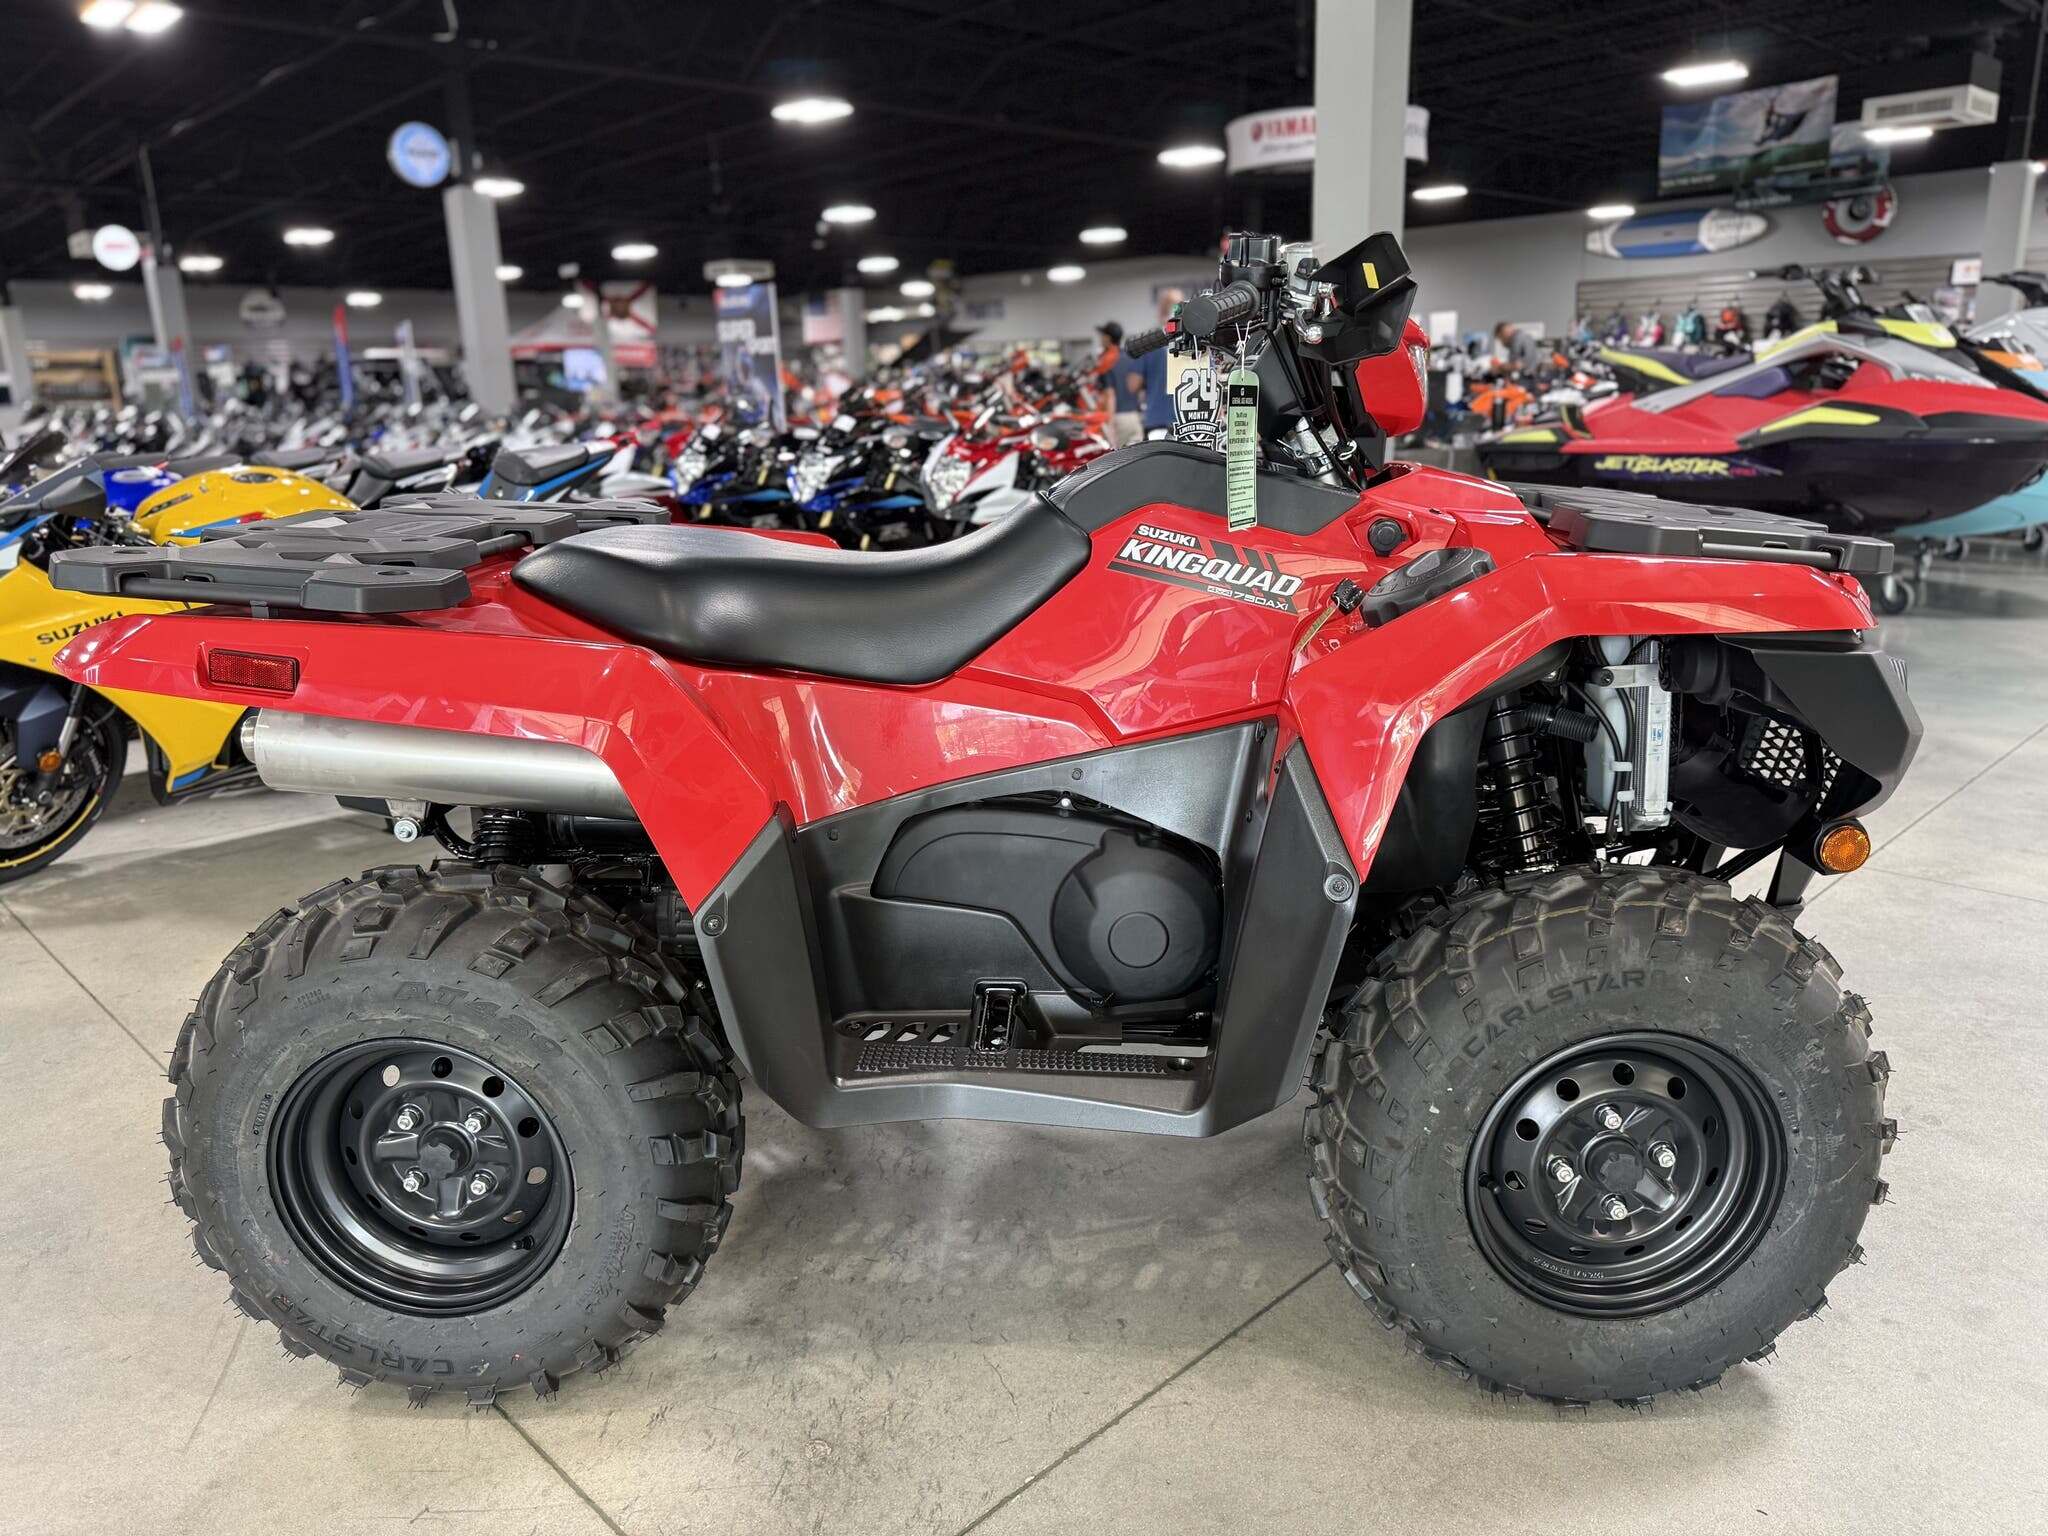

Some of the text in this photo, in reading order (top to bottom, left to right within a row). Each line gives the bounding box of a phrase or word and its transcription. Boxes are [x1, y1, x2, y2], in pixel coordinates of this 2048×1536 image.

[1180, 369, 1218, 411] 24
[1188, 411, 1209, 420] MONTH
[1137, 524, 1196, 548] SUZUKI
[1120, 538, 1302, 596] KINGQUAD
[1462, 969, 1646, 1058] CARLSTAR
[271, 1293, 455, 1375] CARLSTAR
